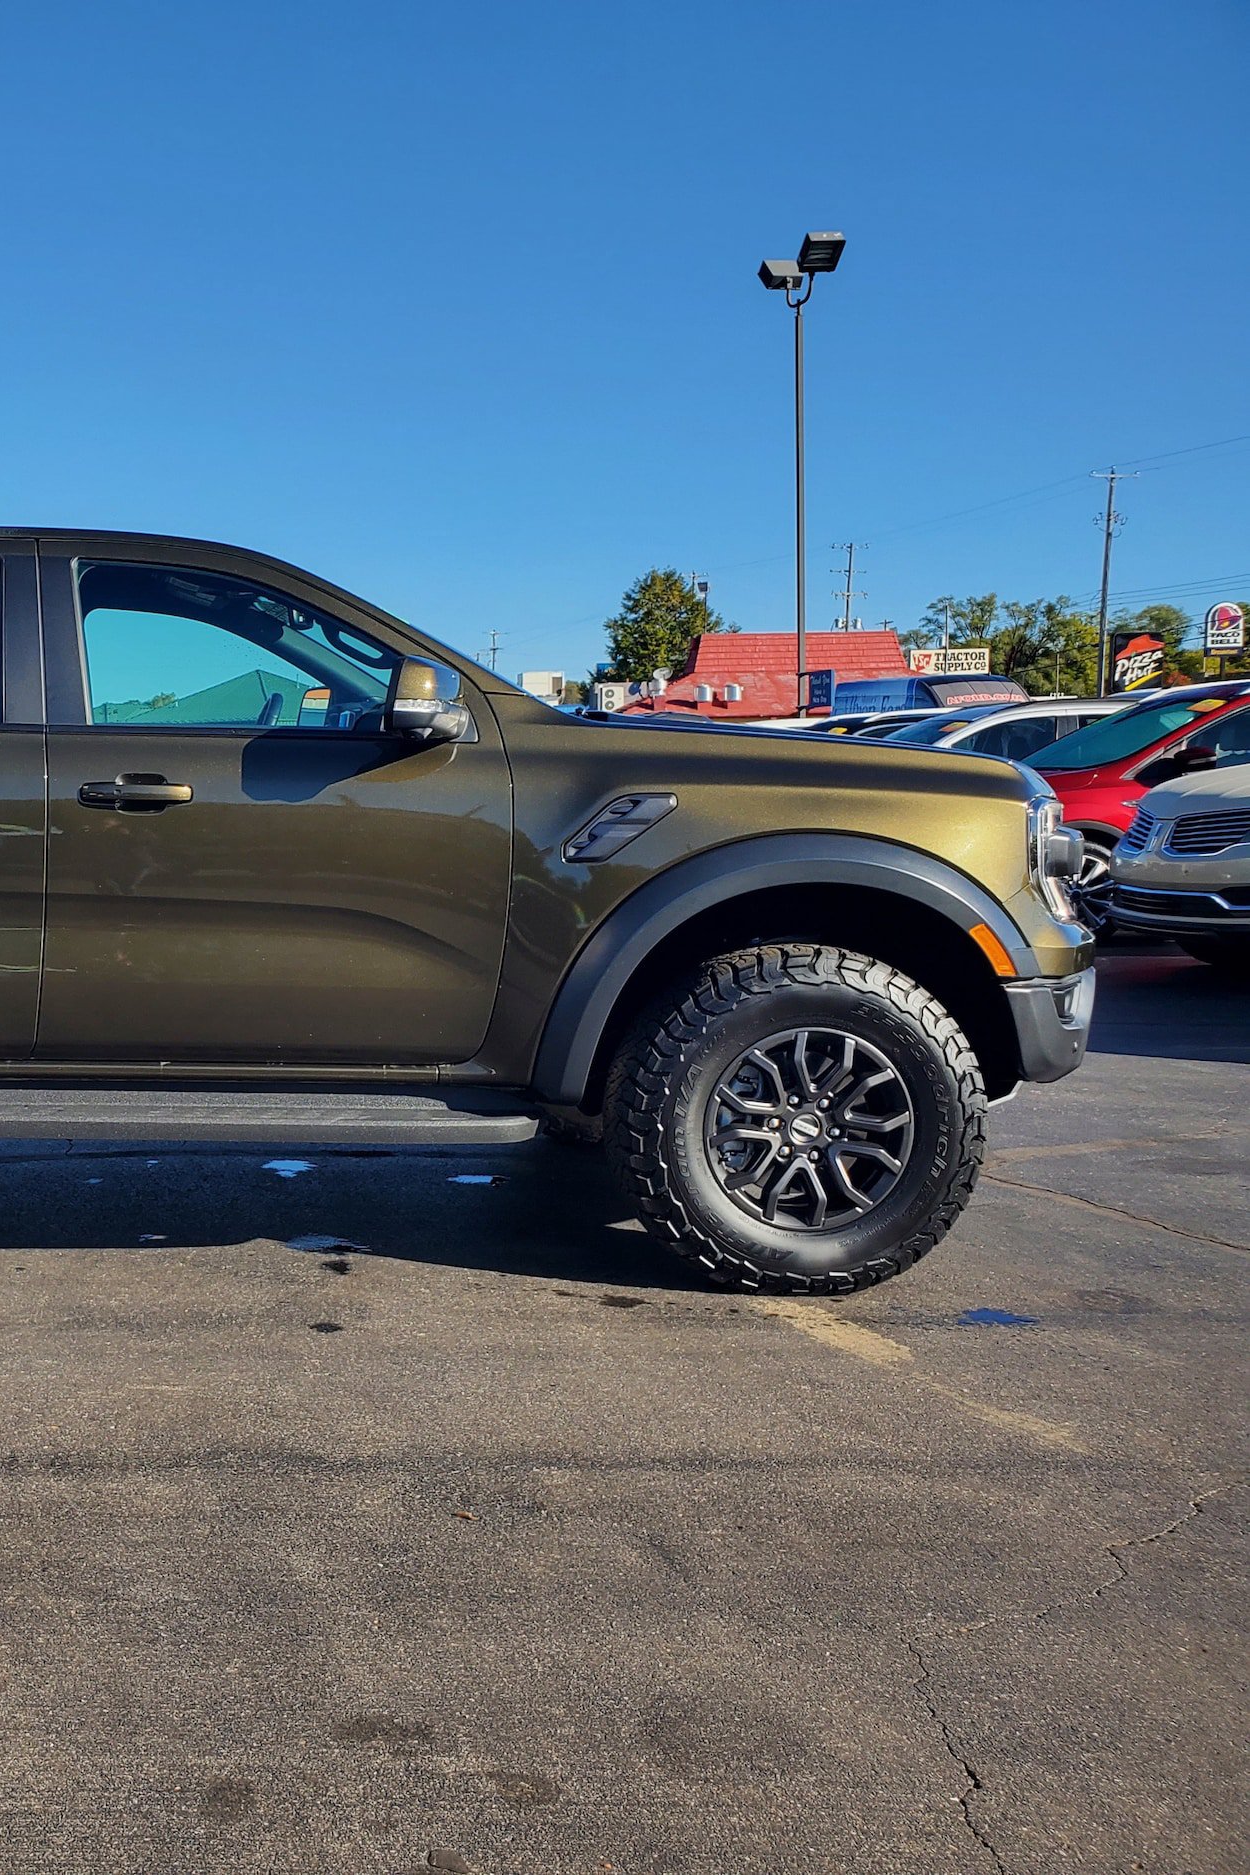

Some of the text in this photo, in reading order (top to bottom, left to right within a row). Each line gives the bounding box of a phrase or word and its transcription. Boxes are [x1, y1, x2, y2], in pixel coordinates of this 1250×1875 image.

[912, 653, 931, 668] TSC
[934, 652, 986, 662] TRACTOR
[934, 662, 974, 672] SUPPLY
[1114, 650, 1164, 682] Pizza
[1122, 662, 1160, 686] Hut
